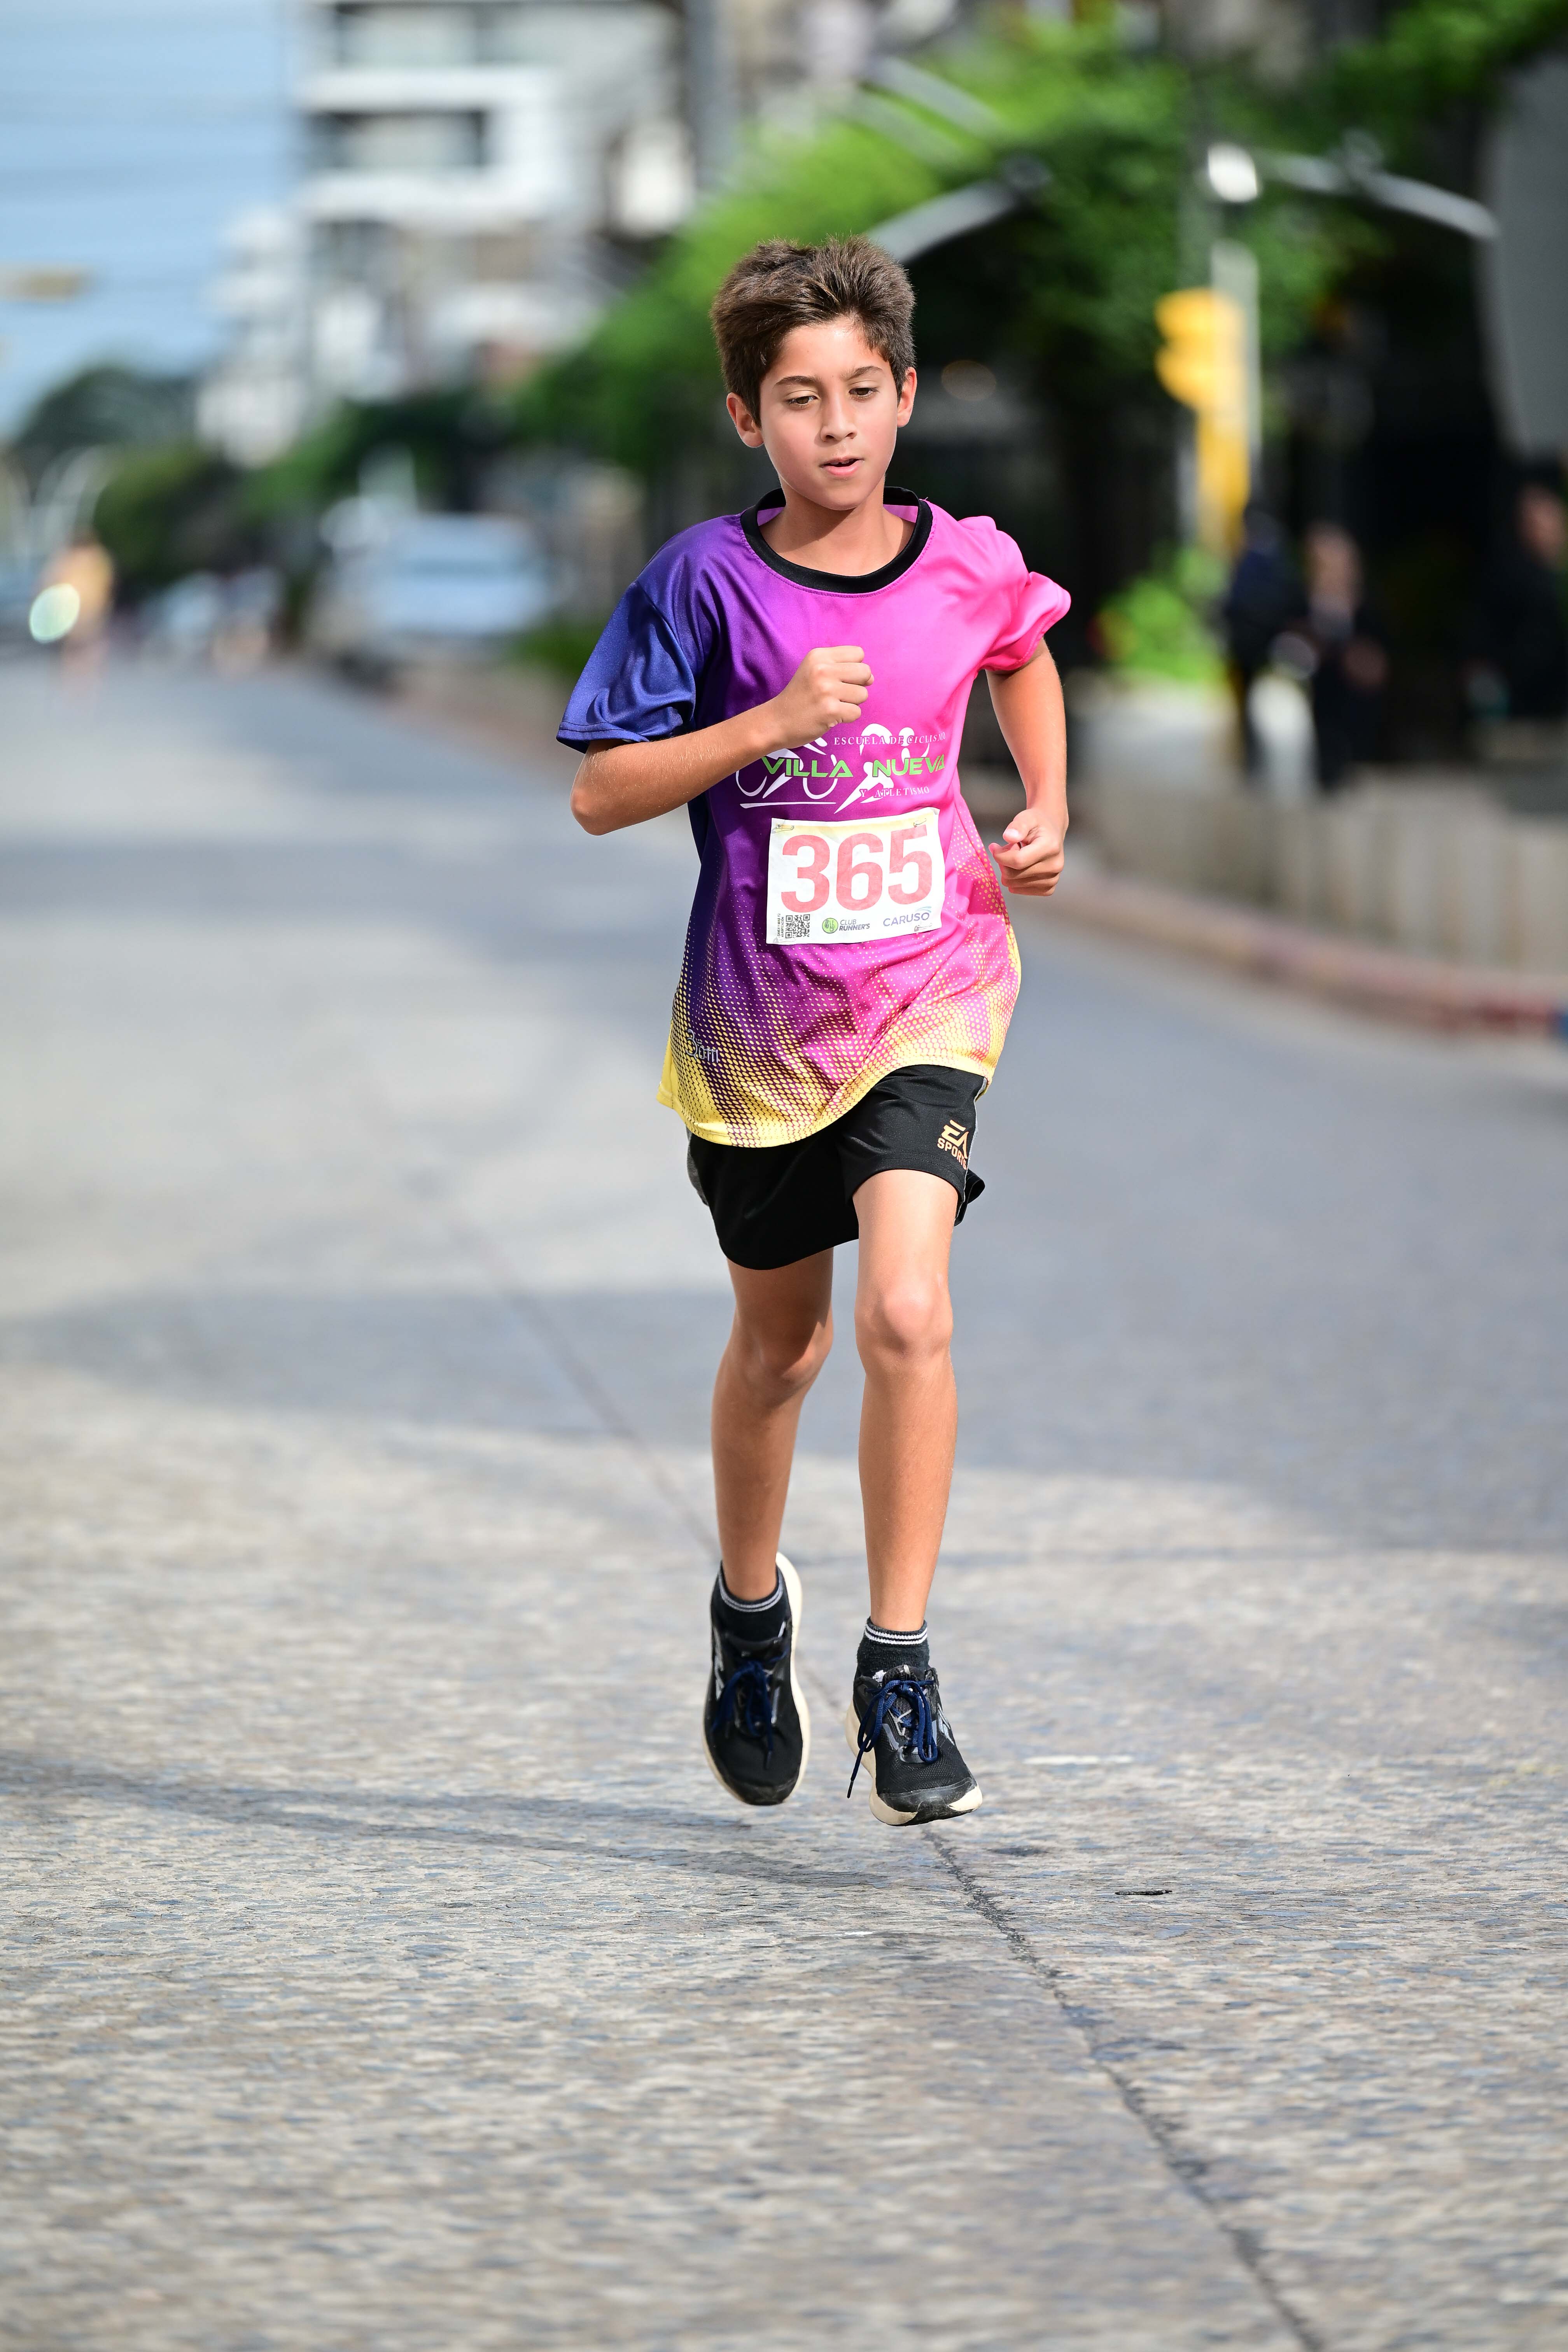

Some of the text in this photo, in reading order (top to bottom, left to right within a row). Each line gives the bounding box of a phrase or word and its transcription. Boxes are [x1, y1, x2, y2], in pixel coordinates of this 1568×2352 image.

[834, 732, 946, 745] ESCUELA DE CICLISMO
[761, 754, 945, 778] VILLA NUEVA
[859, 786, 929, 798] Y ATLETISMO
[781, 824, 932, 913] 365
[883, 912, 930, 926] CARUSO
[941, 1119, 970, 1159] EA
[937, 1138, 967, 1170] SPORTS
